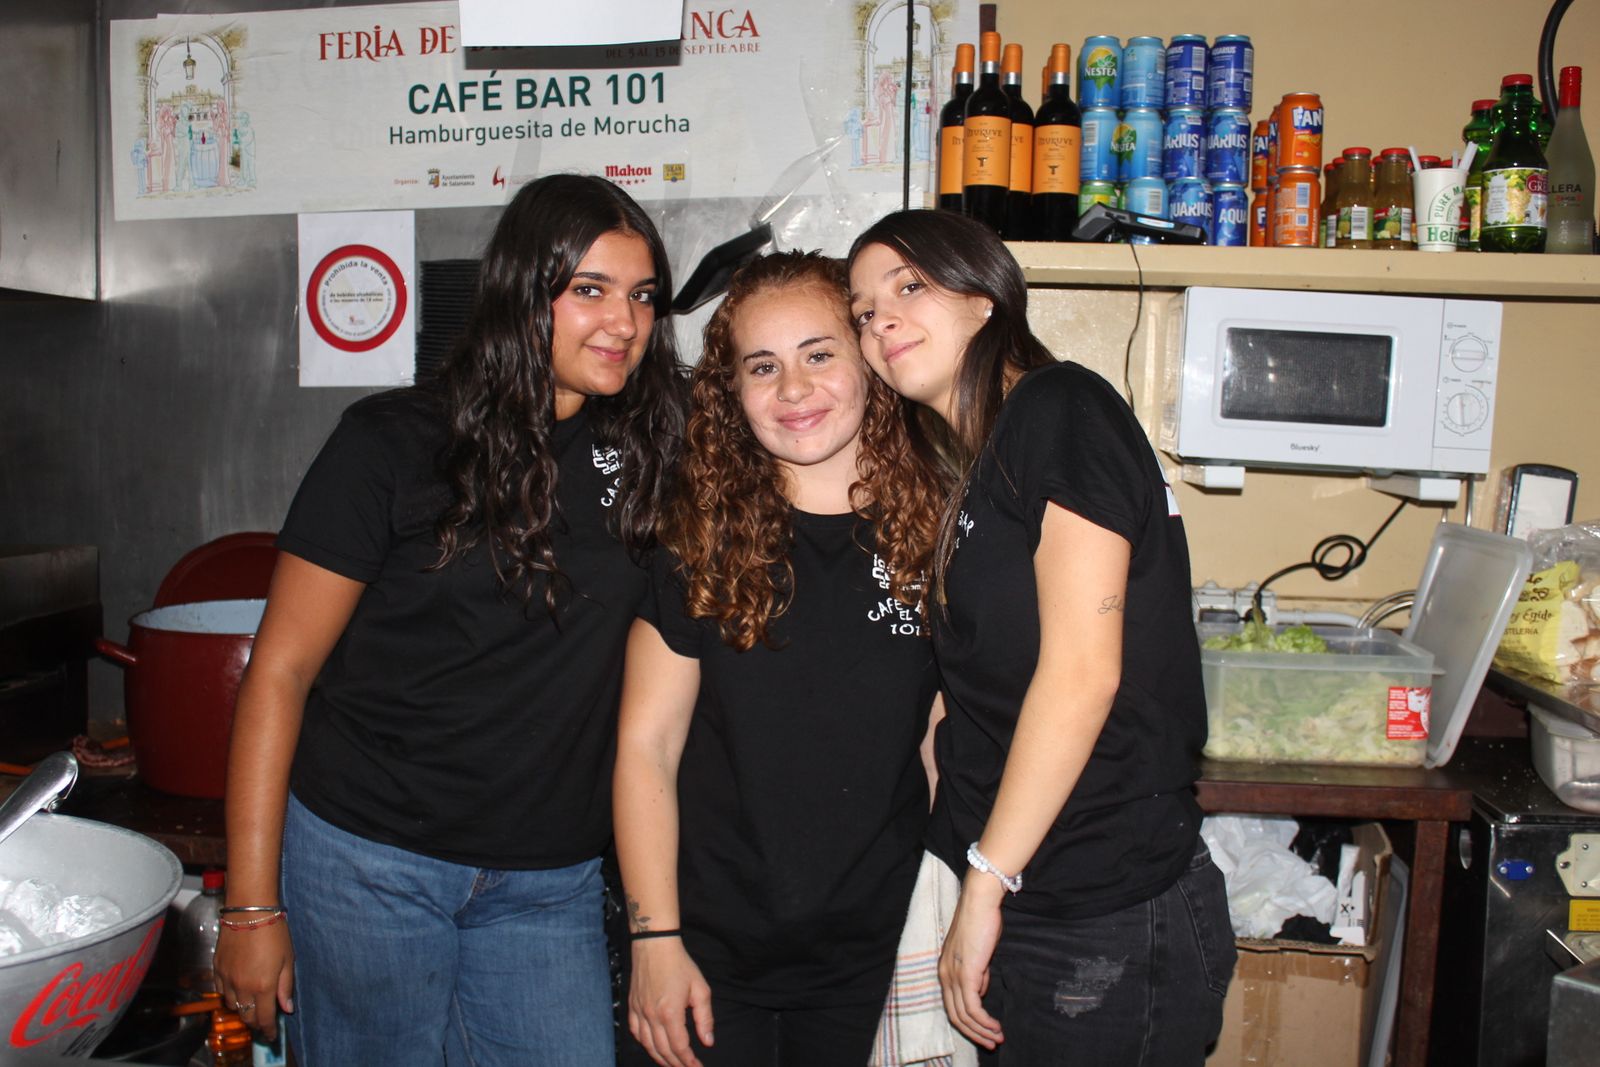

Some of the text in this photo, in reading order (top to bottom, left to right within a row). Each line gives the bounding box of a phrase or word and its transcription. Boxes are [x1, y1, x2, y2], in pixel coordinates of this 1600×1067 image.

[318, 9, 761, 62] FERIA DE NCA
[1085, 67, 1117, 77] NESTEA
[408, 70, 665, 115] CAFÉ BAR 101
[1292, 106, 1322, 128] FAN
[389, 114, 690, 146] Hamburguesita de Morucha
[605, 164, 652, 177] Mahou
[1548, 183, 1582, 193] LERA
[1434, 193, 1451, 218] PURE
[370, 264, 388, 286] venta
[1290, 442, 1320, 452] Bluesky
[899, 609, 913, 621] EL
[890, 623, 920, 637] 101
